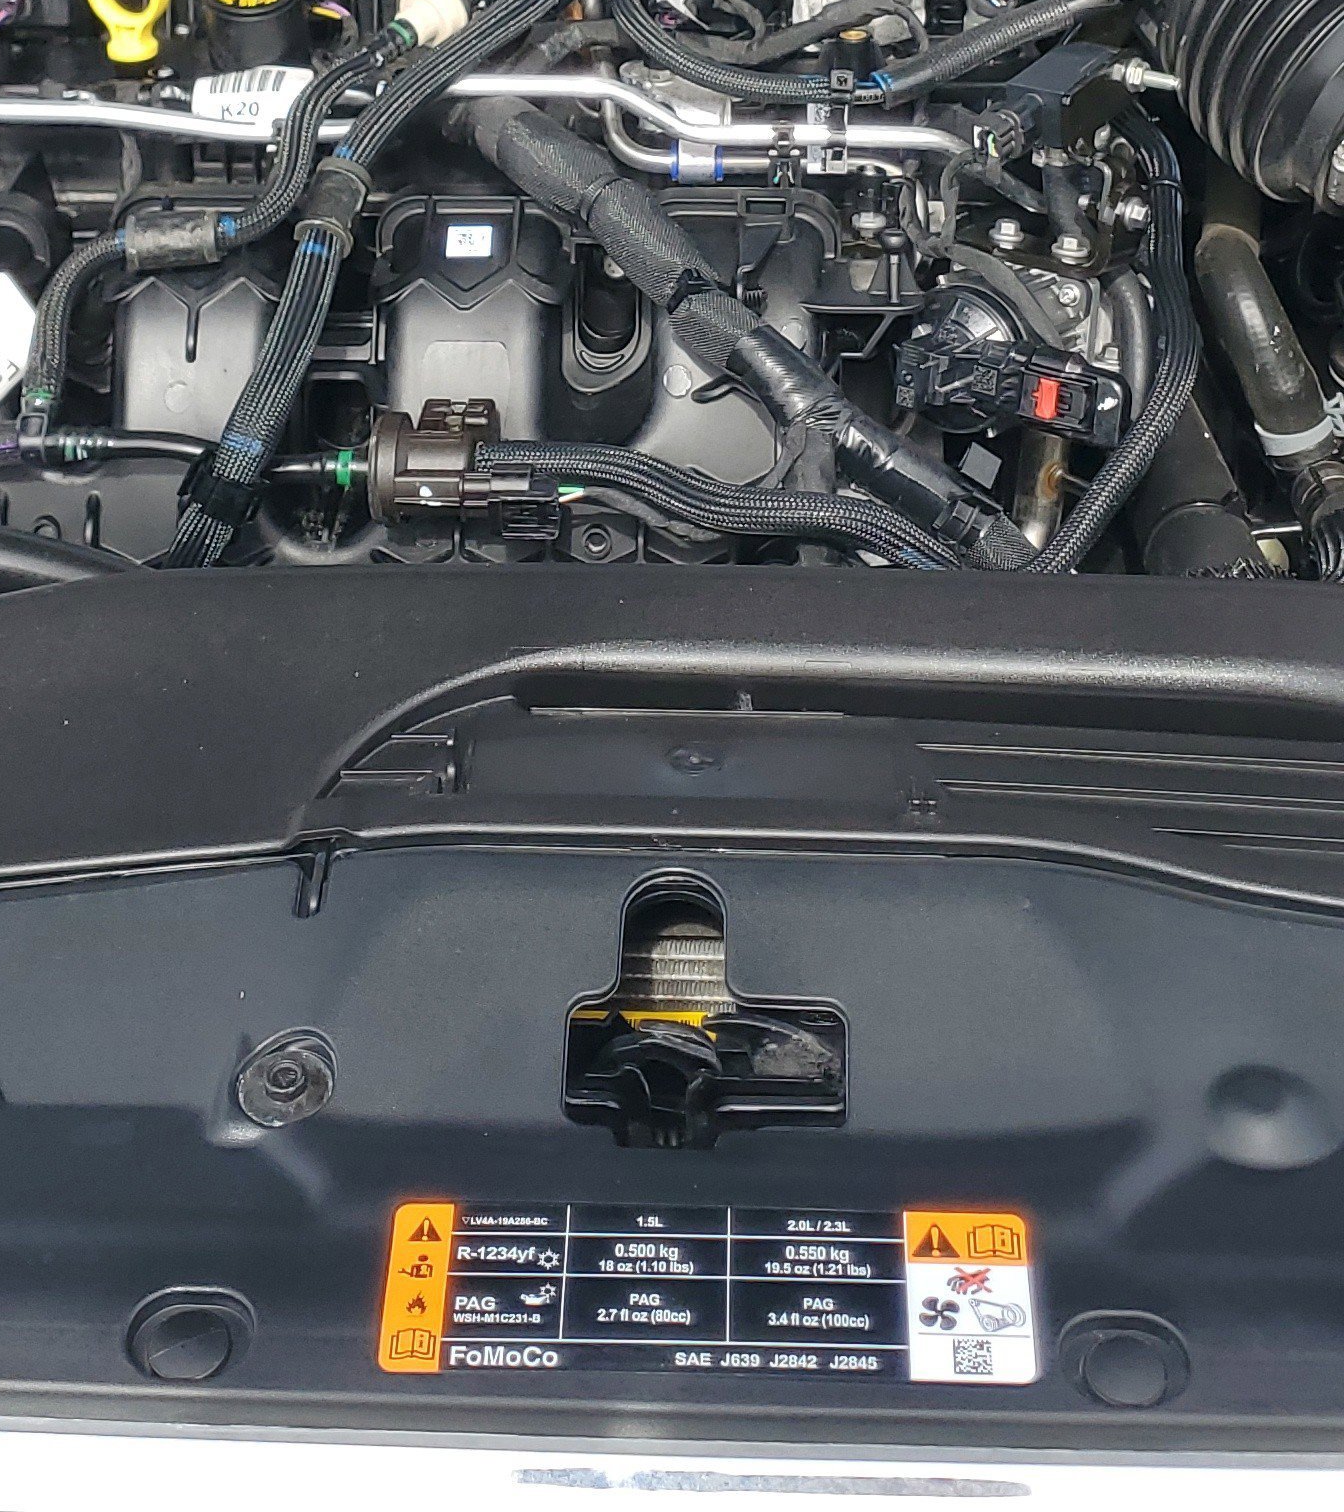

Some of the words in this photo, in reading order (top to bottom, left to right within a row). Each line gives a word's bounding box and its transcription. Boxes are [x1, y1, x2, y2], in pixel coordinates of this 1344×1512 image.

[636, 1216, 664, 1227] 1.5L
[787, 1220, 815, 1232] 2.0L
[823, 1221, 851, 1232] 2.3L
[457, 1246, 536, 1263] R-1234yf
[614, 1244, 655, 1258] 0.500
[659, 1245, 679, 1260] kg
[785, 1245, 826, 1260] 0.550
[830, 1247, 850, 1263] kg
[598, 1260, 614, 1272] 18
[616, 1264, 633, 1272] oz
[636, 1261, 667, 1273] (1.10
[669, 1262, 694, 1275] lbs)
[764, 1262, 792, 1274] 19.5
[794, 1265, 810, 1275] oz
[812, 1263, 843, 1277] (1.21
[847, 1264, 871, 1278] lbs)
[454, 1296, 497, 1311] PAG
[629, 1293, 660, 1306] PAG
[803, 1297, 834, 1311] PAG
[453, 1313, 541, 1324] WSH-M1C231-B
[597, 1309, 617, 1322] 2.7
[631, 1313, 648, 1322] oz
[651, 1309, 691, 1325] (80cc)
[767, 1312, 787, 1326] 3.4
[802, 1316, 819, 1326] oz
[821, 1313, 870, 1329] (100cc)
[449, 1345, 558, 1368] FoMoCo
[674, 1352, 711, 1366] SAE
[720, 1353, 760, 1367] J639
[769, 1353, 818, 1368] J2842
[829, 1355, 878, 1370] J2845
